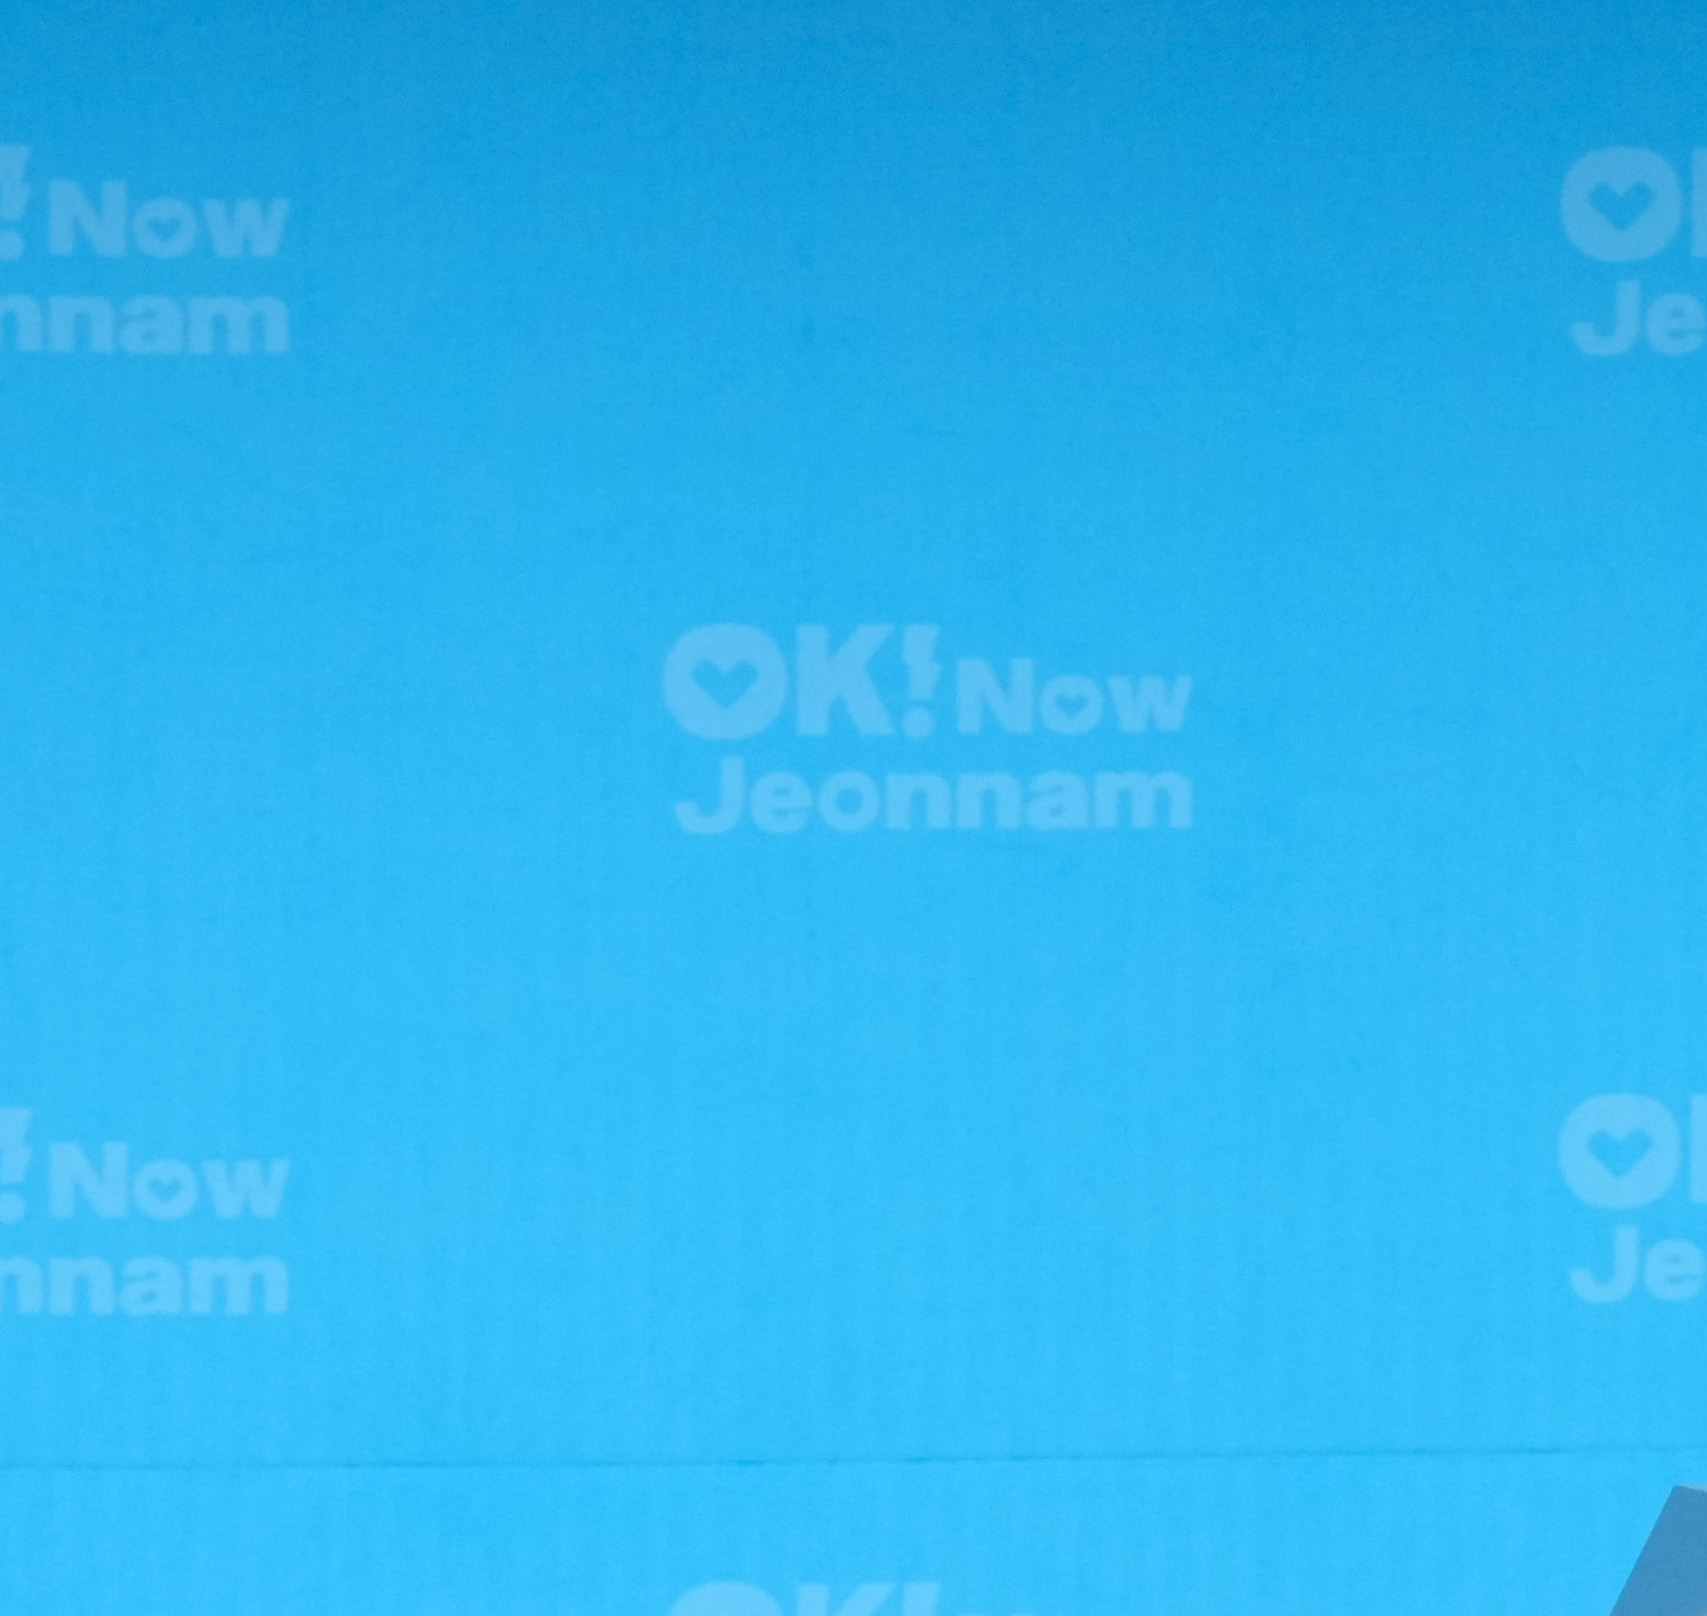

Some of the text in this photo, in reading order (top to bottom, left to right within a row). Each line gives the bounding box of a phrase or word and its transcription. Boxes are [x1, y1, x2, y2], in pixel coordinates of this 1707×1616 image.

[0, 293, 291, 355] nnam
[673, 755, 1195, 835] Jeonnam
[0, 1253, 291, 1317] nnam
